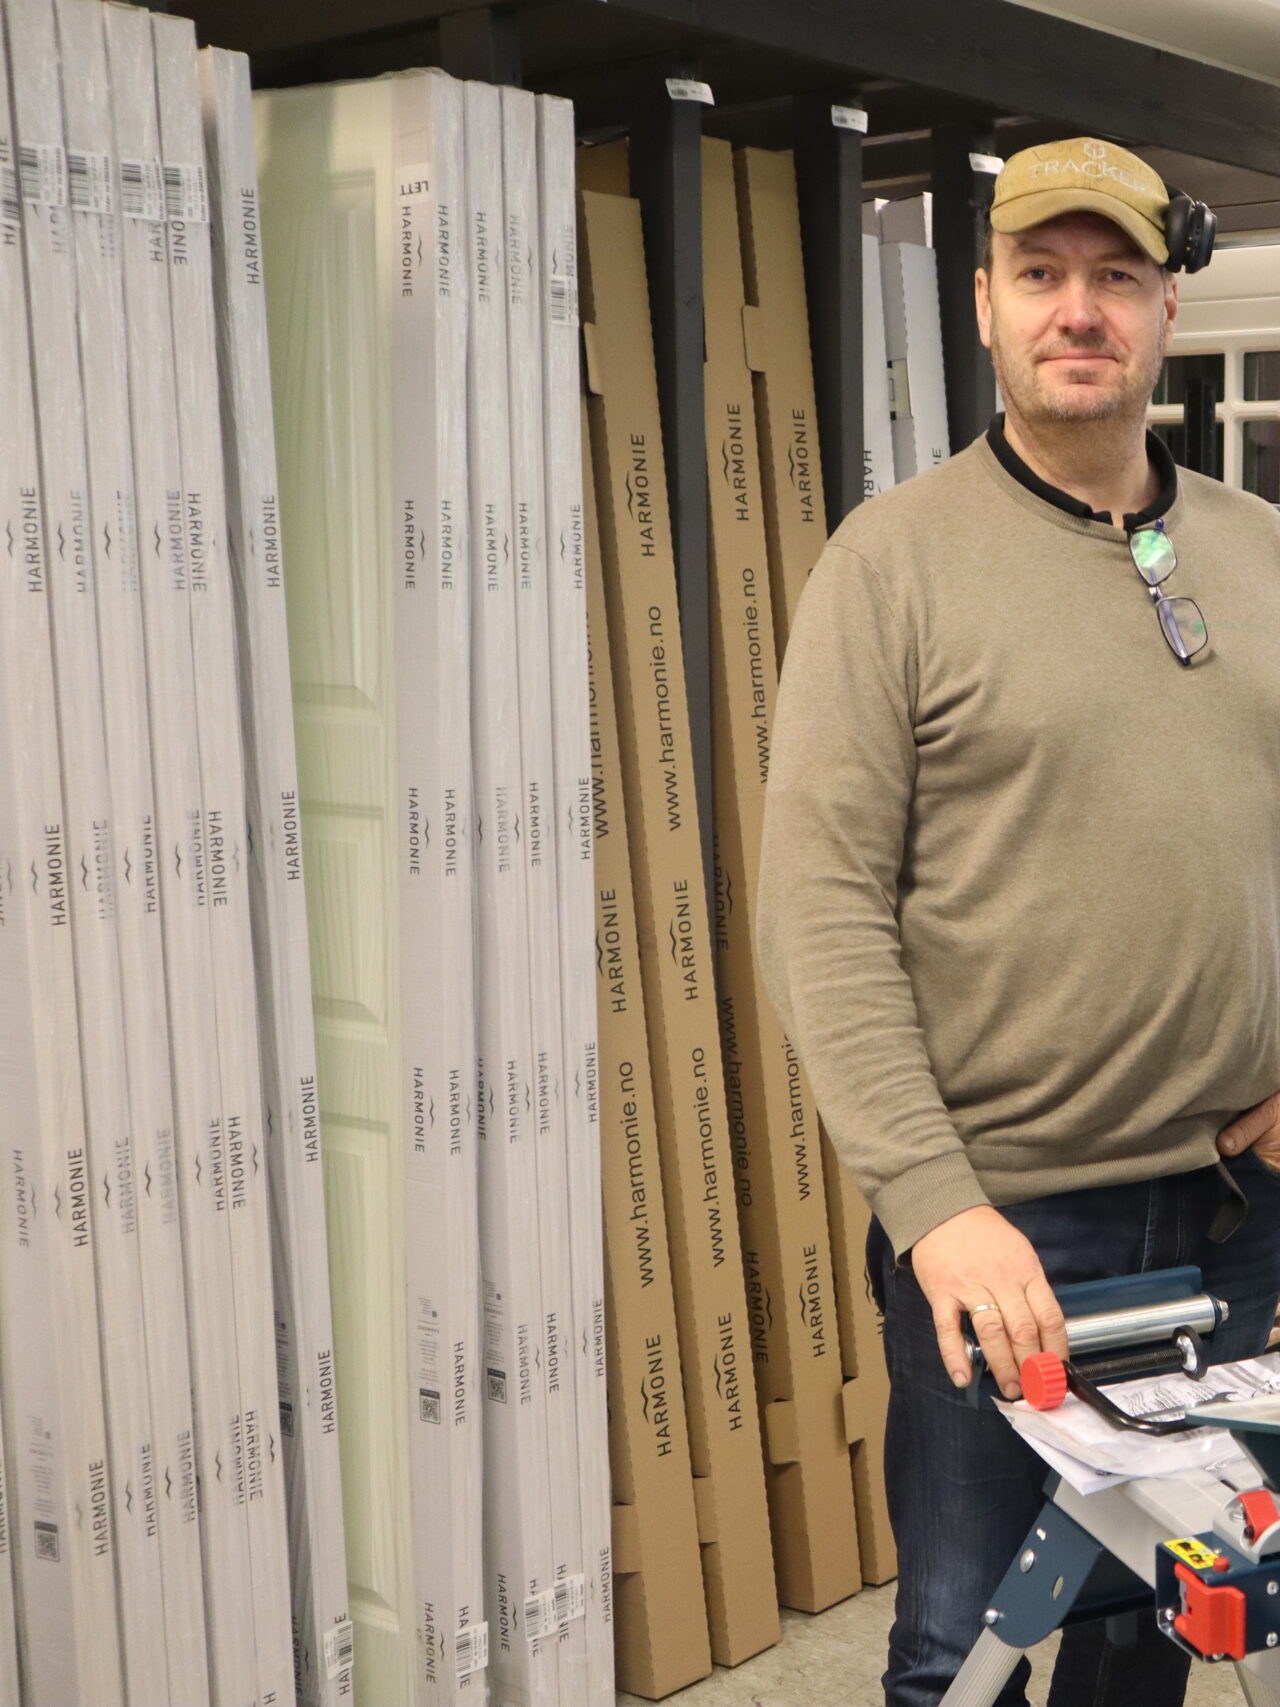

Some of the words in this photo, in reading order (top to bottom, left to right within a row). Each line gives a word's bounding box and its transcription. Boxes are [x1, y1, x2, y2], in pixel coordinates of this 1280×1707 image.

[400, 180, 429, 197] LETT
[241, 187, 261, 285] HARMONIE
[402, 205, 413, 297] HARMONIE
[438, 204, 451, 298] HARMONIE
[476, 211, 490, 303] HARMONIE
[631, 433, 656, 556] HARMONIE
[727, 403, 750, 521] HARMONIE
[793, 408, 815, 522] HARMONIE
[21, 487, 43, 592] HARMONIE
[187, 493, 208, 592] HARMONIE
[262, 495, 281, 588] HARMONIE
[404, 500, 416, 590] HARMONIE
[441, 500, 453, 590] HARMONIE
[485, 503, 499, 592] HARMONIE
[519, 502, 532, 591] HARMONIE
[570, 504, 584, 589] HARMONIE
[648, 606, 682, 831] www.harmonie.no
[742, 567, 769, 784] www.harmonie.no
[208, 810, 228, 907] HARMONIE
[282, 790, 301, 880] HARMONIE
[408, 787, 420, 875] HARMONIE
[444, 789, 456, 877] HARMONIE
[529, 782, 541, 867] HARMONIE
[578, 777, 591, 860] HARMONIE
[45, 824, 67, 926] HARMONIE
[602, 889, 627, 1013] HARMONIE
[674, 880, 699, 1000] HARMONIE
[300, 1075, 319, 1163] HARMONIE
[413, 1067, 425, 1153] HARMONIE
[449, 1069, 461, 1156] HARMONIE
[507, 1060, 521, 1144] HARMONIE
[537, 1052, 551, 1135] HARMONIE
[585, 1041, 598, 1124] HARMONIE
[722, 996, 753, 1208] www.harmonie.no
[12, 1150, 29, 1249] HARMONIE
[67, 1148, 89, 1248] HARMONIE
[209, 1117, 226, 1212] HARMONIE
[228, 1116, 248, 1210] HARMONIE
[619, 1061, 655, 1288] www.harmonie.no
[692, 1048, 726, 1268] www.harmonie.no
[746, 1252, 769, 1363] HARMONIE
[804, 1243, 827, 1358] HARMONIE
[318, 1349, 336, 1435] HARMONIE
[453, 1341, 466, 1427] HARMONIE
[517, 1324, 531, 1406] HARMONIE
[546, 1313, 560, 1395] HARMONIE
[646, 1334, 672, 1457] HARMONIE
[718, 1312, 743, 1431] HARMONIE
[89, 1459, 110, 1557] HARMONIE
[498, 1573, 511, 1653] HARMONIE
[600, 1546, 614, 1624] HARMONIE
[424, 1602, 437, 1685] HARMONIE
